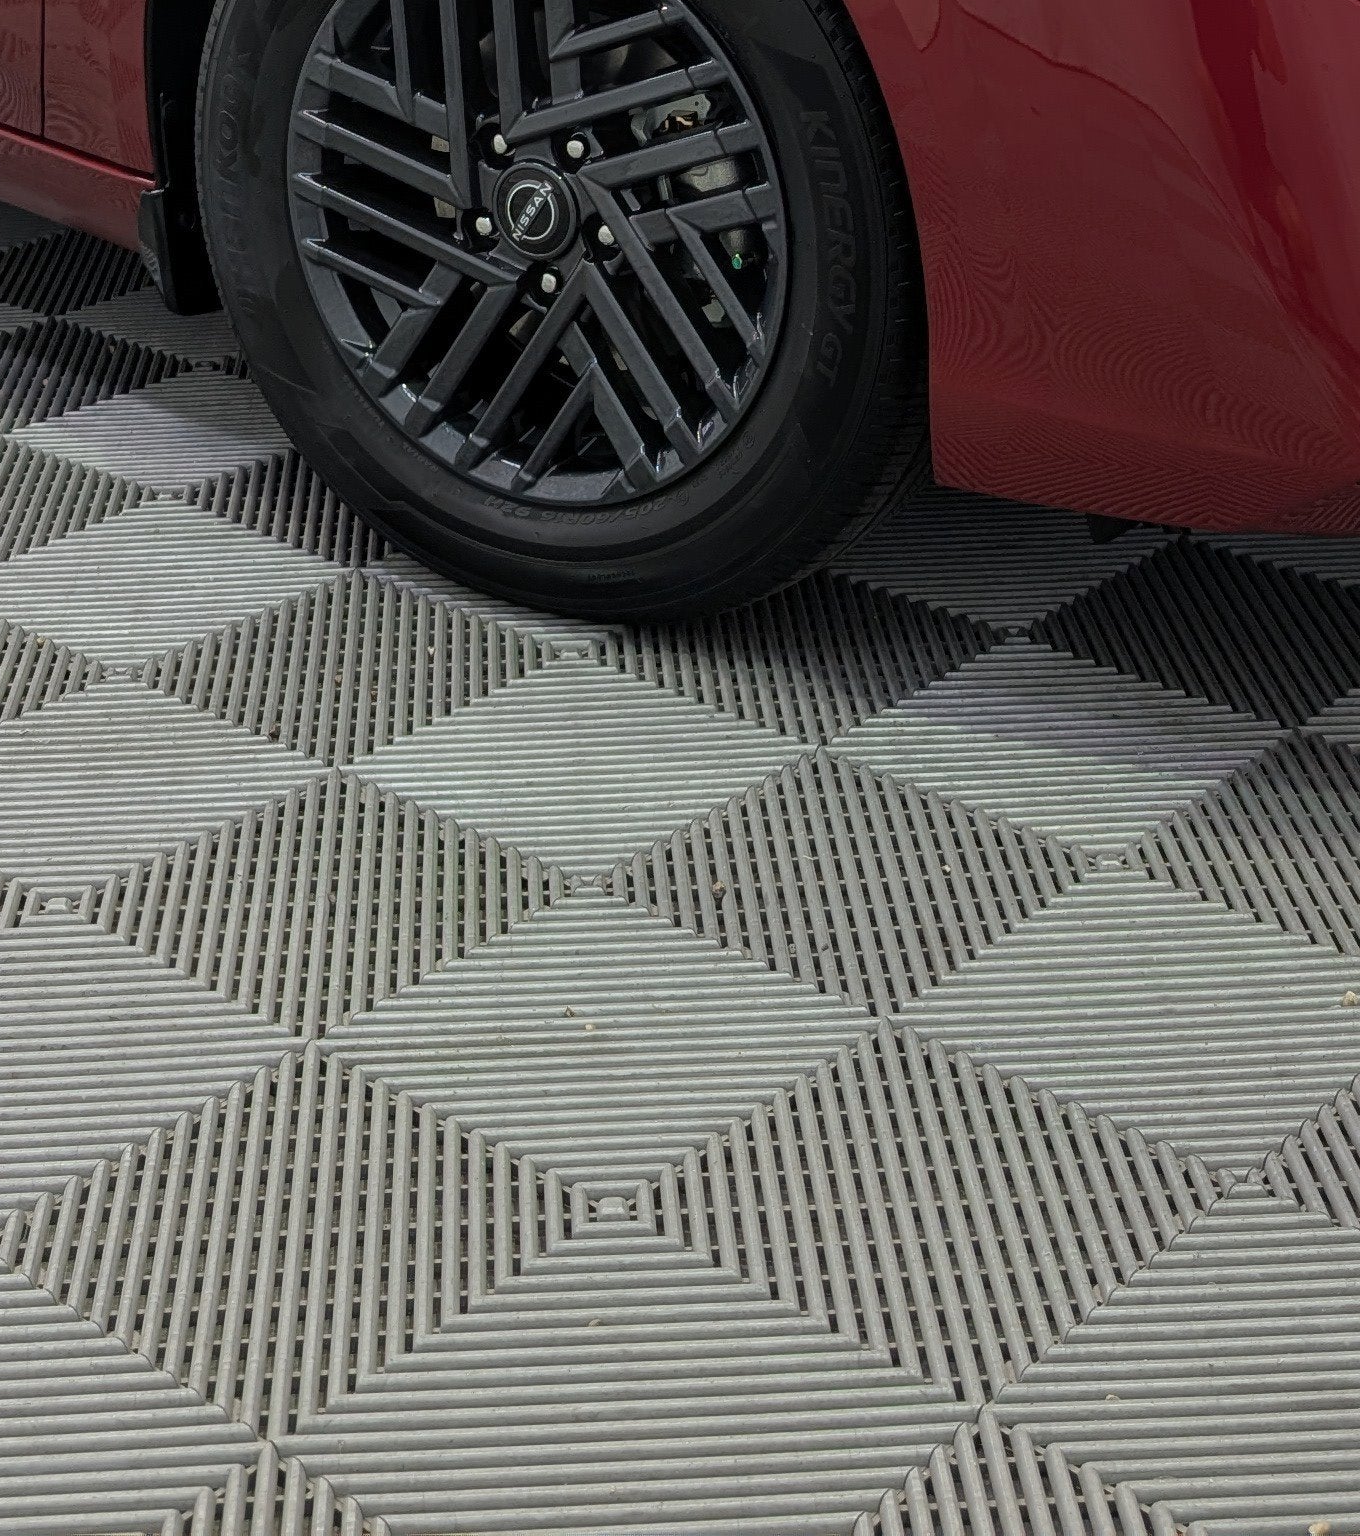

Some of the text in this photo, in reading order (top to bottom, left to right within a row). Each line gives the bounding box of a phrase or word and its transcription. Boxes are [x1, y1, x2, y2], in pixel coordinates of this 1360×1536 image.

[512, 181, 552, 241] NISSAN
[800, 110, 857, 388] KINERGY GT
